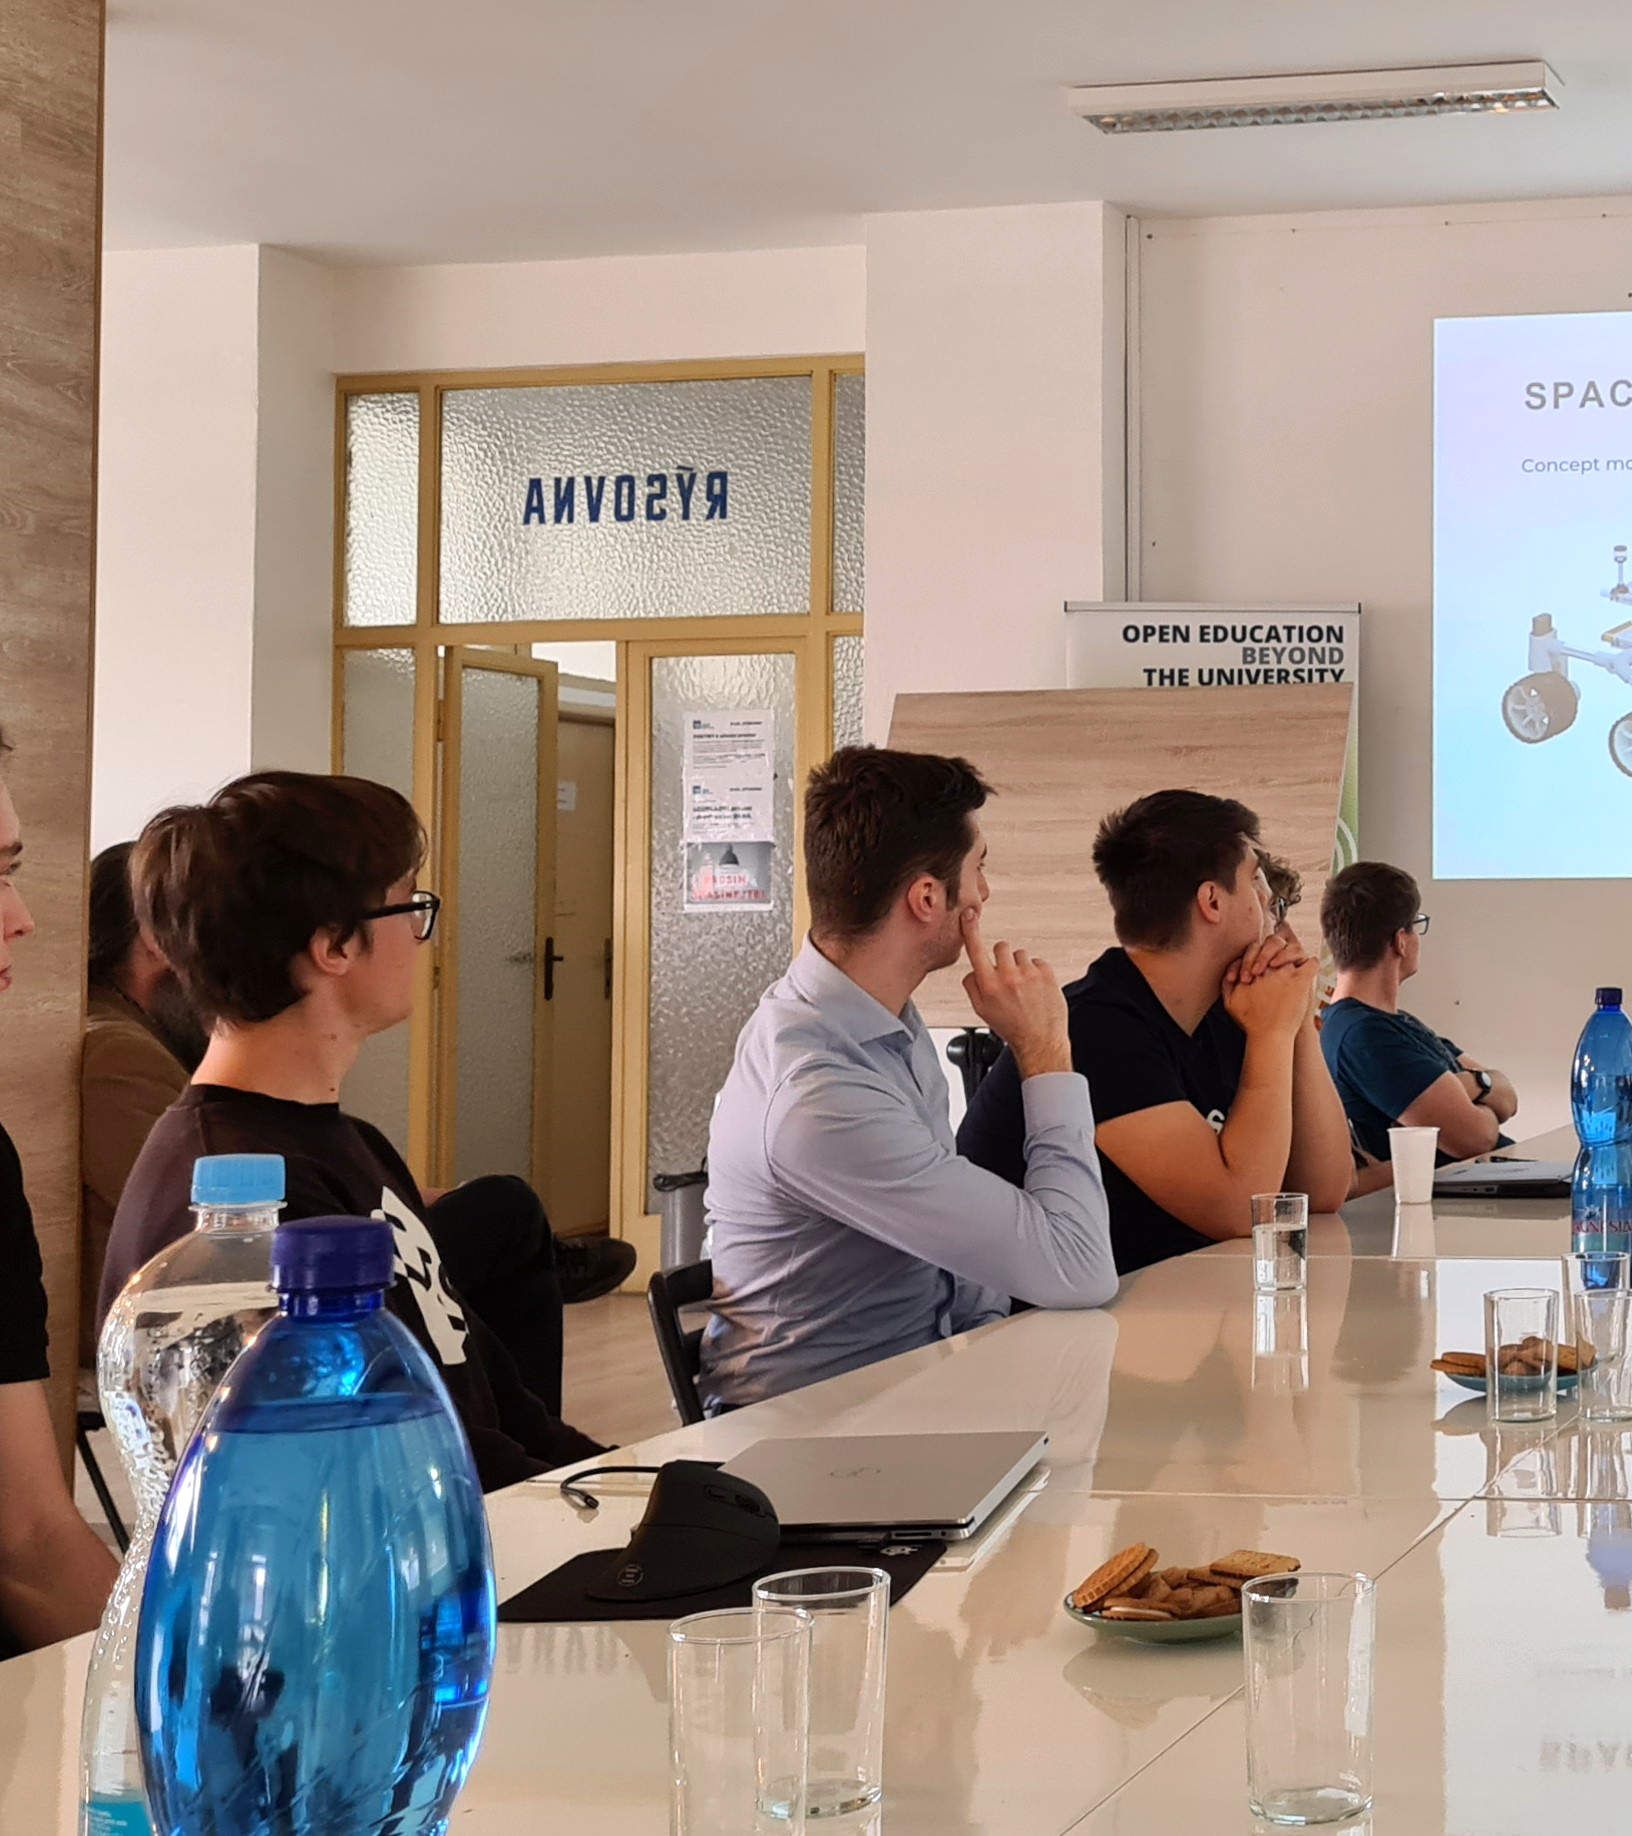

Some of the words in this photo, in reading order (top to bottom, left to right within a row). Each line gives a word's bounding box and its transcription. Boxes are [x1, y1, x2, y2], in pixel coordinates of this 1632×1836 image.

[1521, 456, 1600, 475] Concept
[1122, 625, 1190, 643] OPEN
[1199, 625, 1344, 643] EDUCATION
[1242, 647, 1344, 665] BEYOND
[1143, 668, 1190, 687] THE
[1198, 668, 1345, 686] UNIVERSITY
